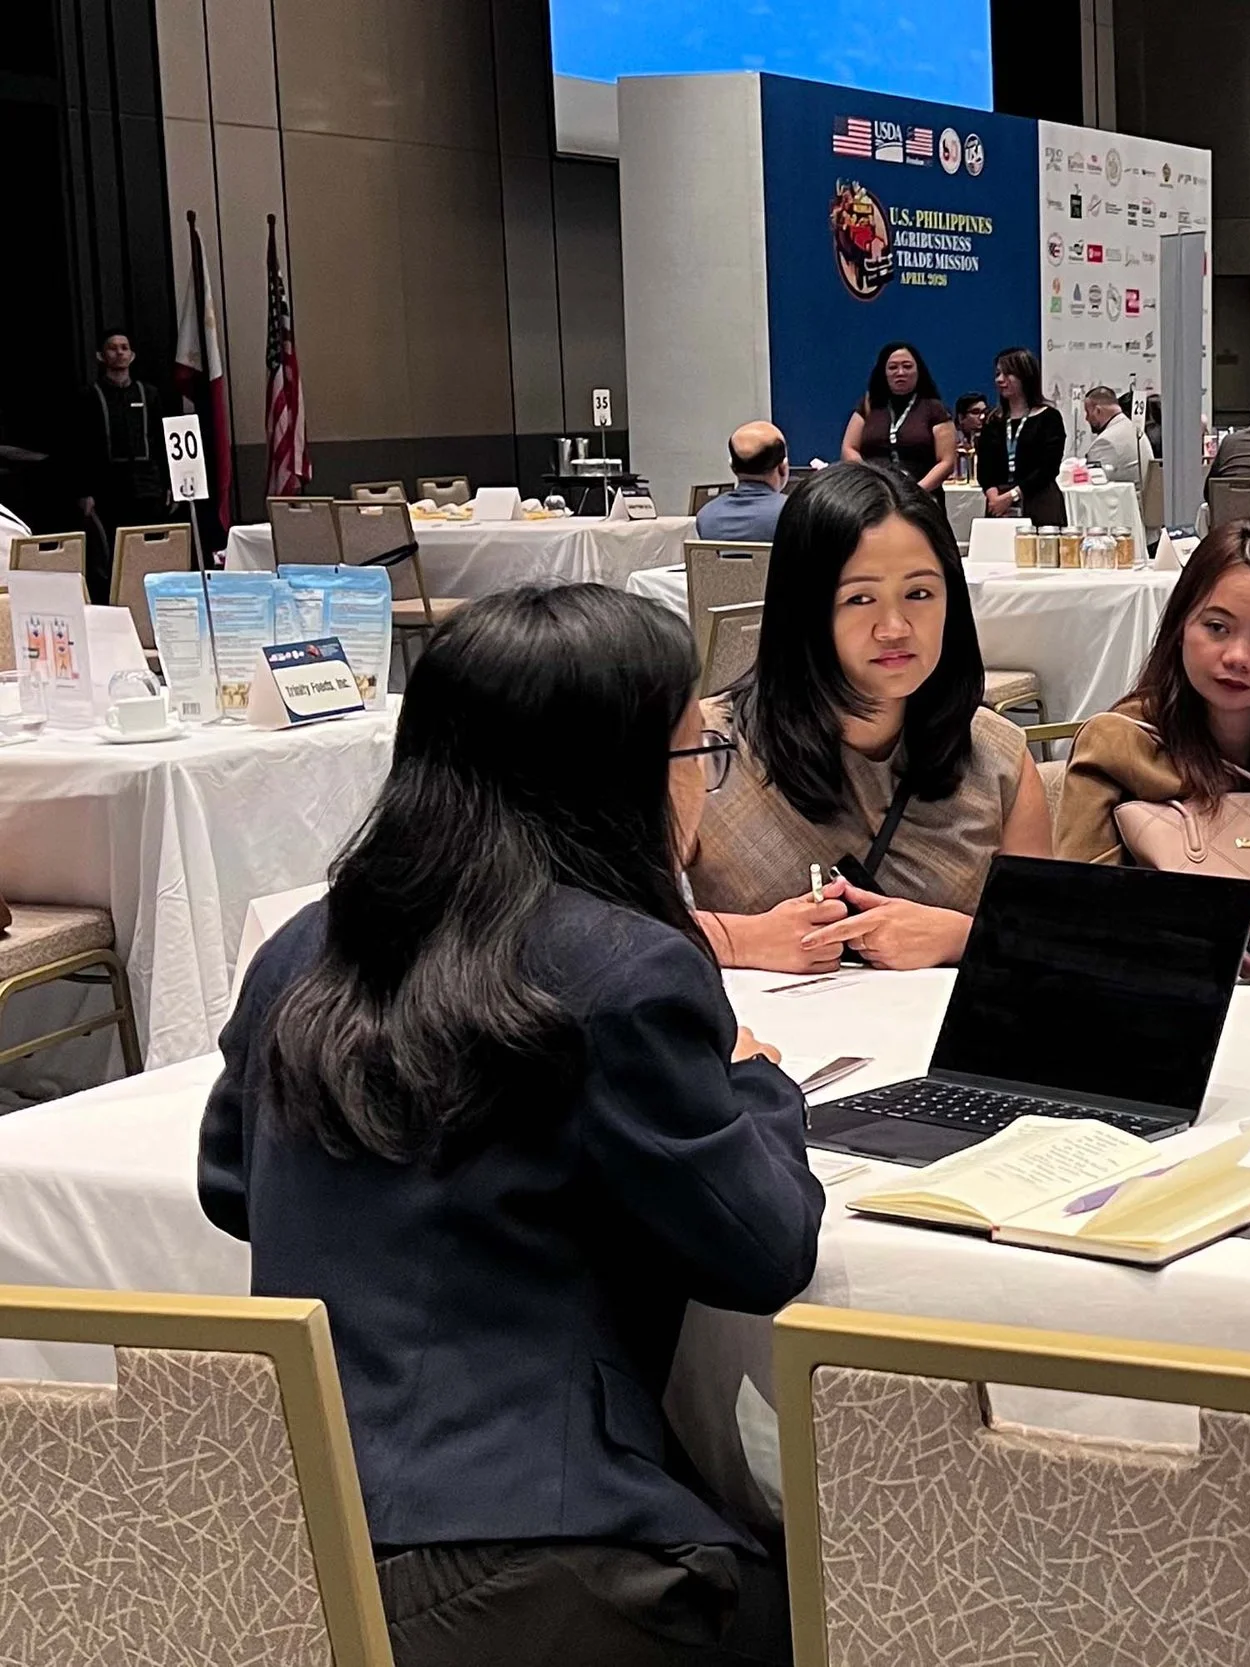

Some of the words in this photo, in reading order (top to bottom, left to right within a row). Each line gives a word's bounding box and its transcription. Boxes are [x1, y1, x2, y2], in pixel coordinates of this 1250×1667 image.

[874, 120, 903, 142] USDA
[893, 230, 972, 252] AGRIBUSINESS
[896, 250, 934, 269] TRADE
[934, 252, 979, 272] MISSION
[900, 271, 927, 285] APRIL
[596, 396, 608, 410] 35
[1134, 400, 1145, 415] 29
[169, 430, 198, 461] 30
[285, 683, 311, 698] Trinity
